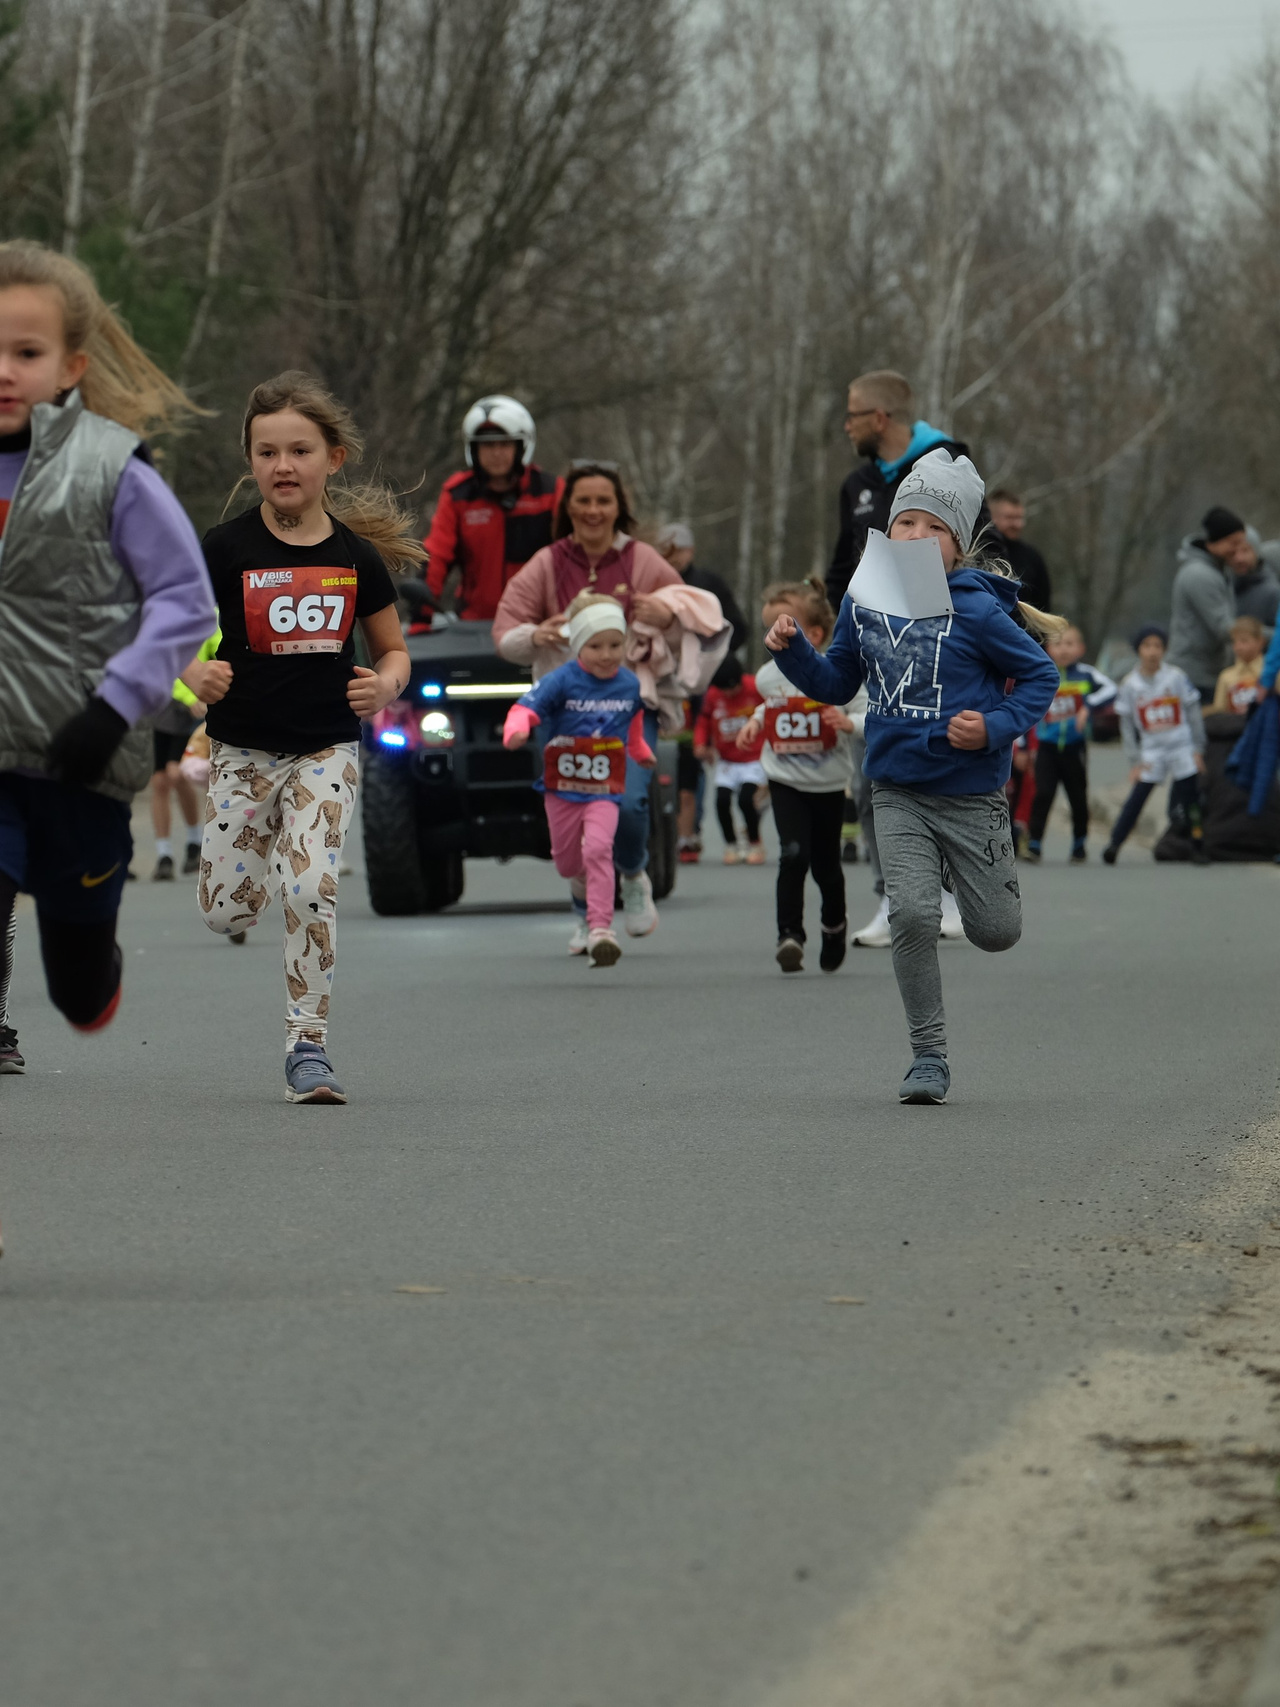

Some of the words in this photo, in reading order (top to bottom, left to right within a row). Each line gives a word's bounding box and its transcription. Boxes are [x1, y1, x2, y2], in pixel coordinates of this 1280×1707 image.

[898, 474, 962, 512] Sweet
[249, 572, 269, 588] IV
[267, 571, 293, 580] BIEG
[321, 577, 340, 587] BIEG
[268, 594, 345, 634] 667
[565, 699, 634, 713] RUNNING
[892, 707, 941, 720] STARS
[775, 712, 820, 739] 621
[557, 752, 610, 781] 628
